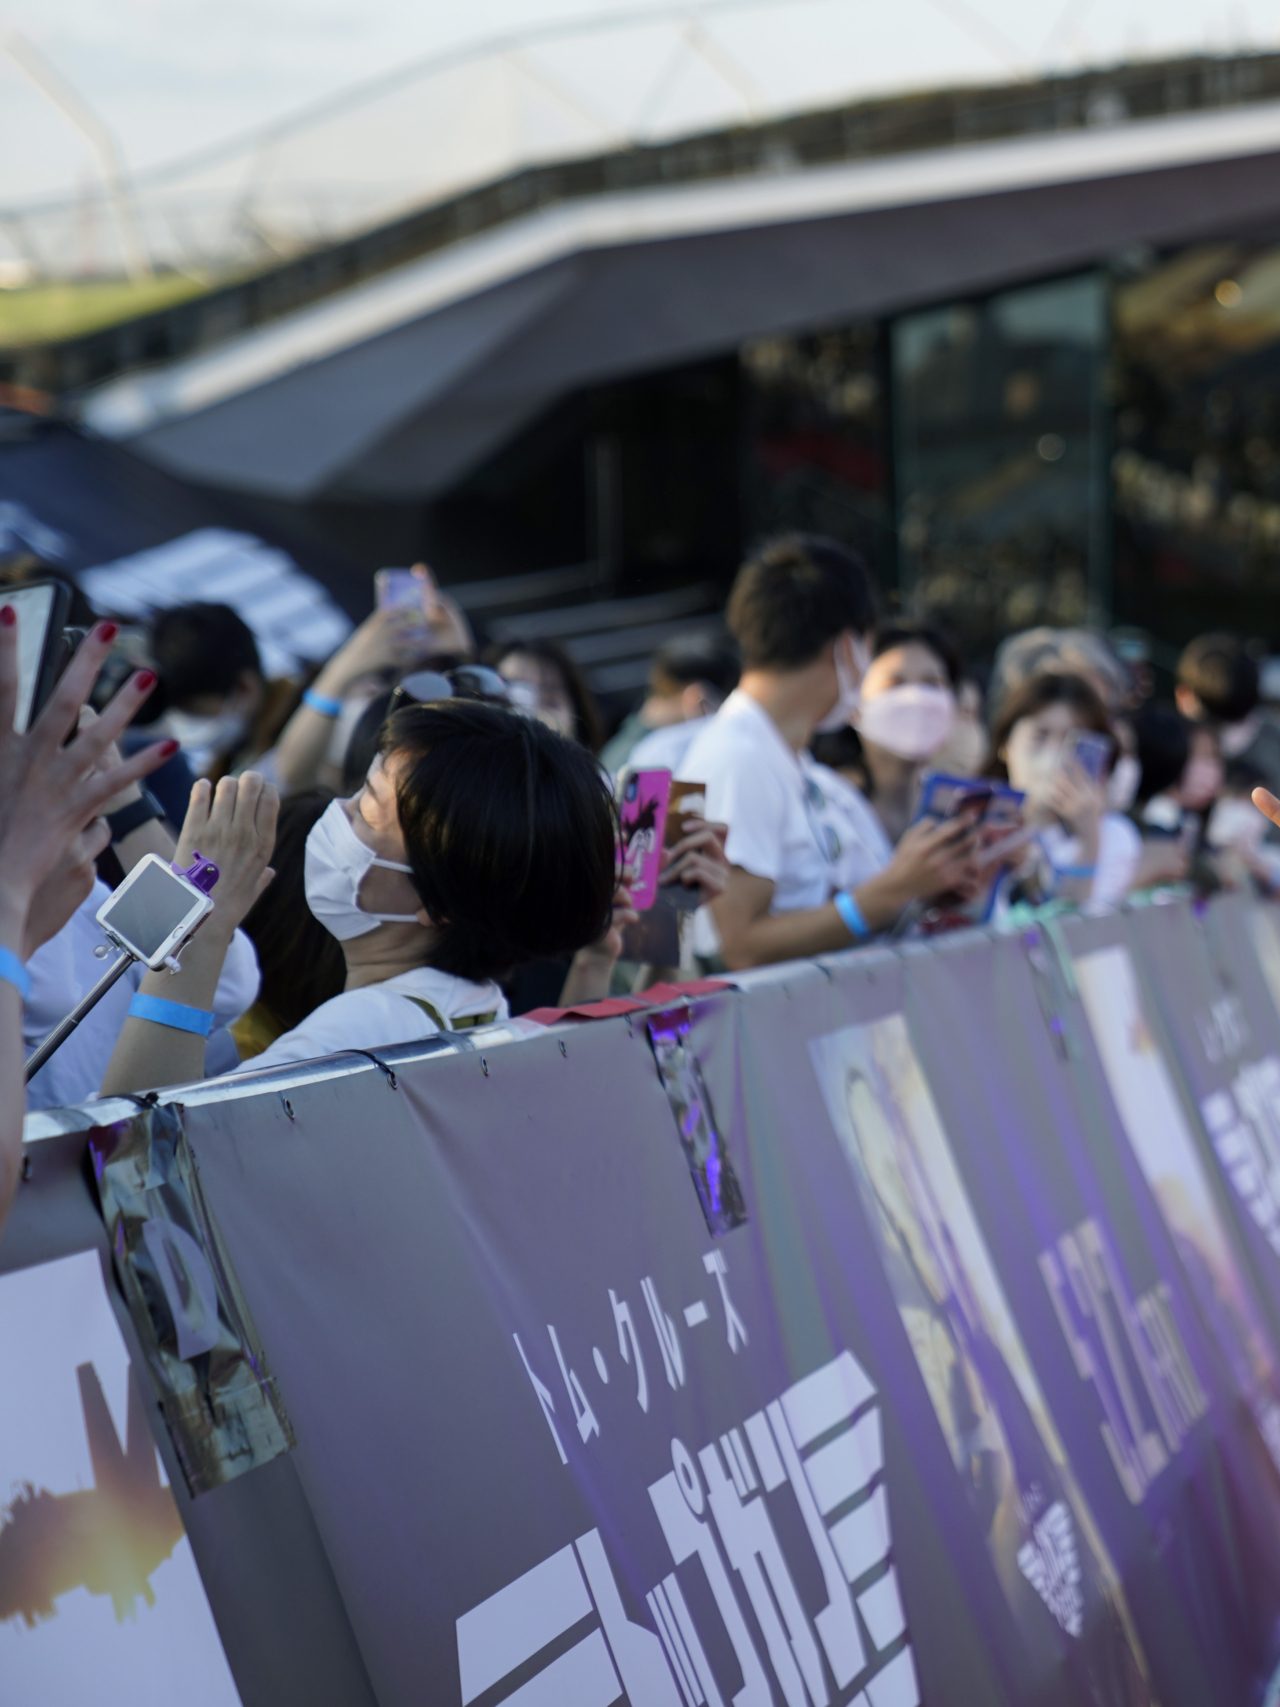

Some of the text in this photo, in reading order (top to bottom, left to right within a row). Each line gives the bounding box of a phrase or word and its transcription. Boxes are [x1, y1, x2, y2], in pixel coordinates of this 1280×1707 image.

[512, 1248, 749, 1465] トム・クルーズ
